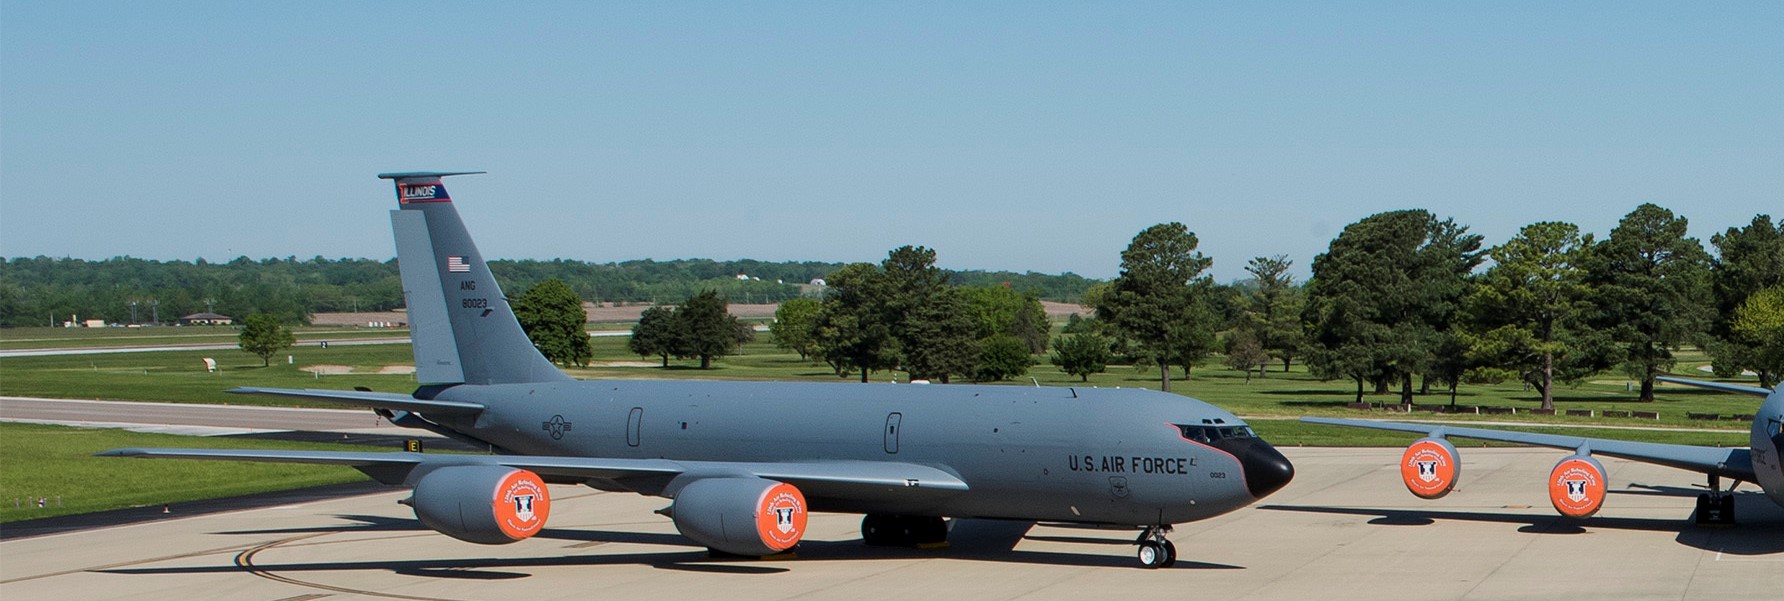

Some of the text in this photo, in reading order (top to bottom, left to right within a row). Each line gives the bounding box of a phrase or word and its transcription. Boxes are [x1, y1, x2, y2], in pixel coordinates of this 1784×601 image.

[399, 183, 436, 204] ILLINOIS
[461, 280, 476, 290] ANG
[462, 298, 487, 308] 80023
[411, 442, 417, 451] E
[1101, 456, 1125, 472] AIR
[1132, 457, 1187, 474] FORCE
